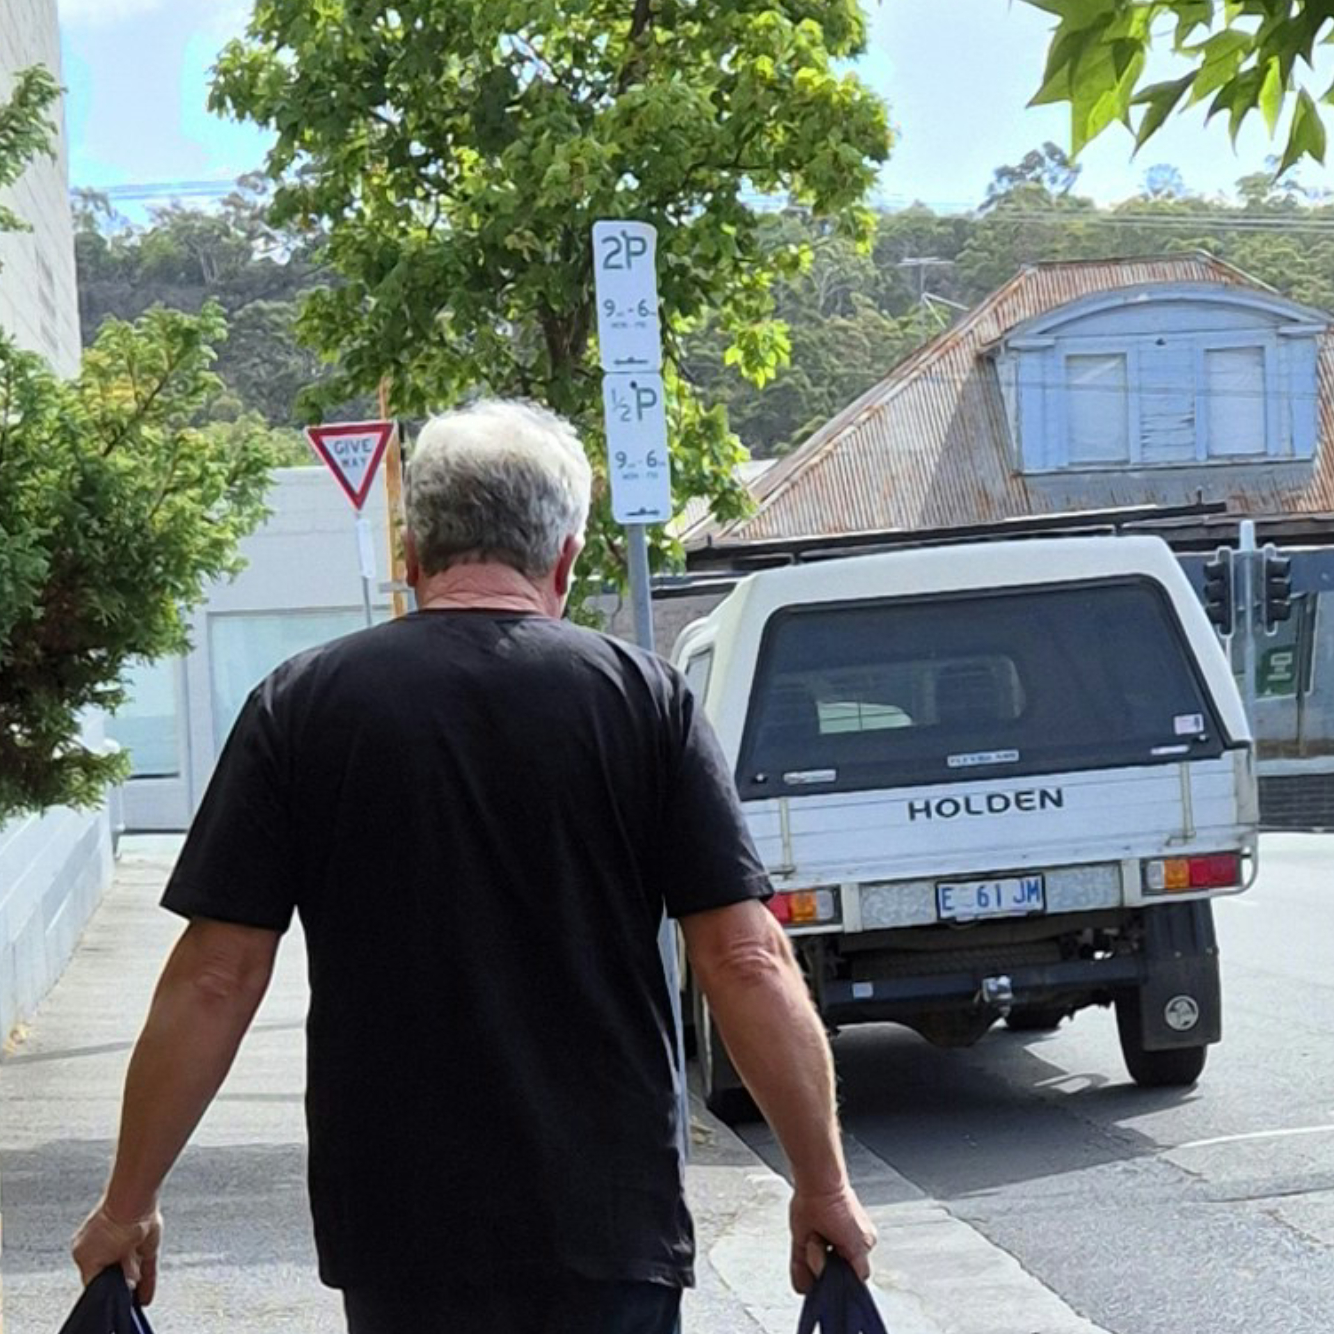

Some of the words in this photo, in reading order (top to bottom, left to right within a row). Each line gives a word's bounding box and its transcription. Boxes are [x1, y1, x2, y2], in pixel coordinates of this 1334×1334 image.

[601, 235, 647, 270] 2P
[334, 439, 372, 455] GIVE
[908, 788, 1064, 822] HOLDEN
